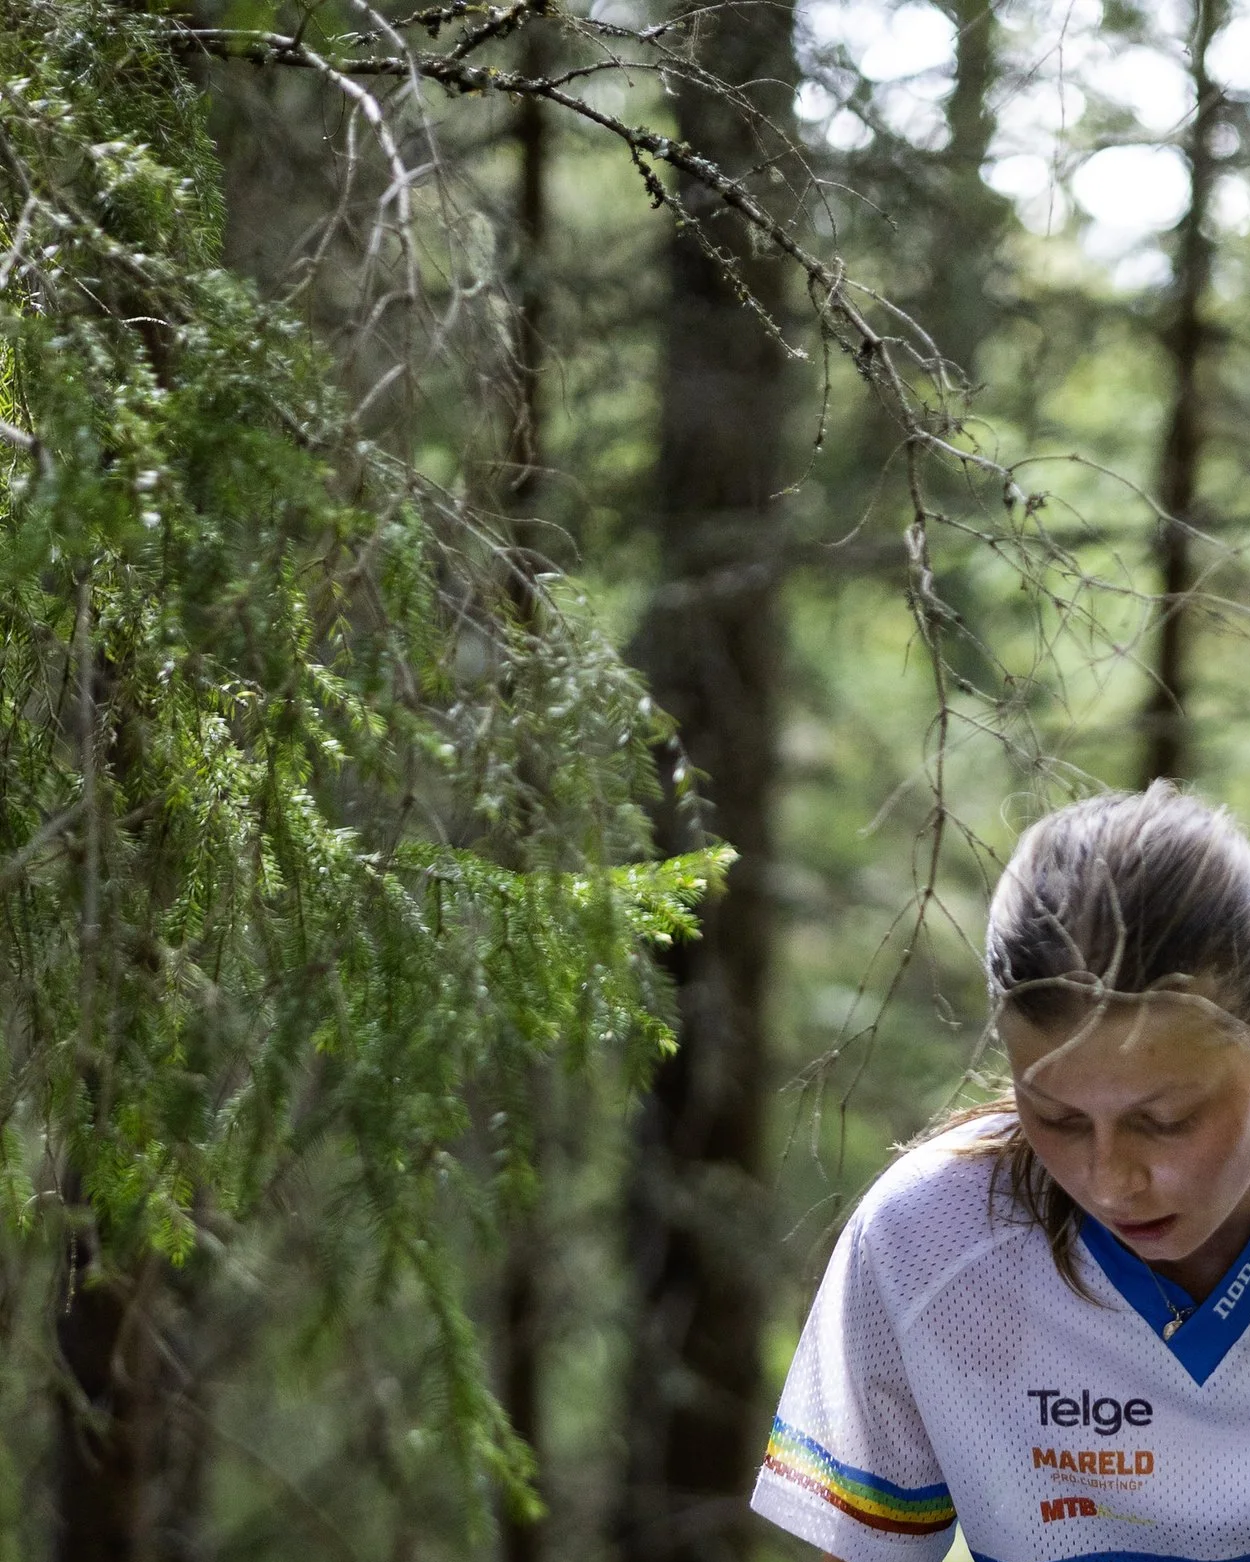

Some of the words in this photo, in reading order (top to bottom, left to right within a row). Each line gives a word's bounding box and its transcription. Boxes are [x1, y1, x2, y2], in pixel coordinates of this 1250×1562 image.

[1027, 1389, 1154, 1436] Telge
[1032, 1447, 1154, 1475] MARELD
[1040, 1497, 1098, 1523] MTB
